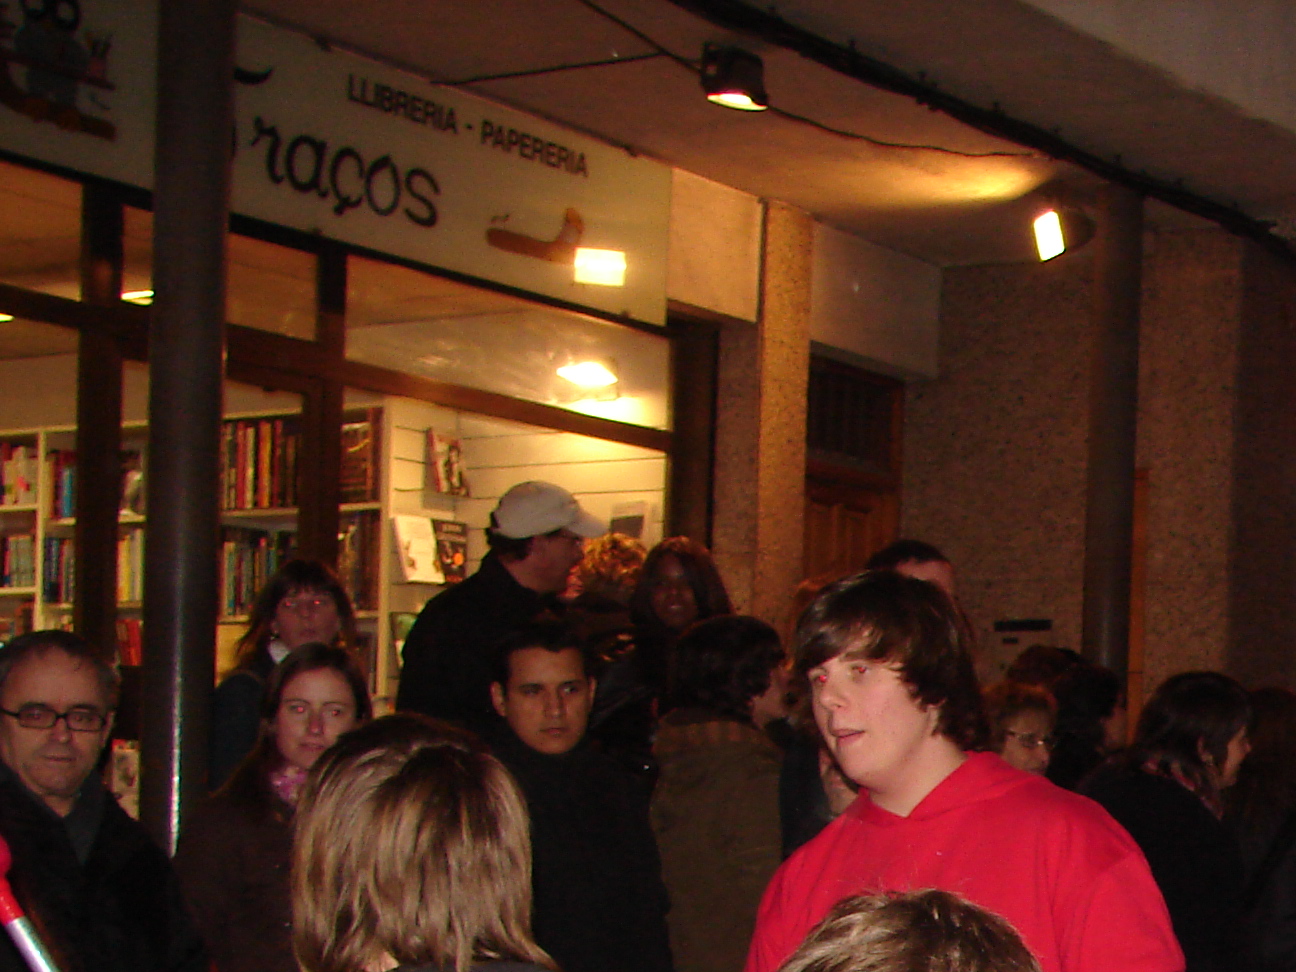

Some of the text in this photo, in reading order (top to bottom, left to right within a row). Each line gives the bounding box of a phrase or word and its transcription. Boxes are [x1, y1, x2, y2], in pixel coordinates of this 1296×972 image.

[234, 67, 440, 228] raços
[347, 73, 457, 134] LLIBRERIA
[480, 118, 589, 178] PAPERERIA
